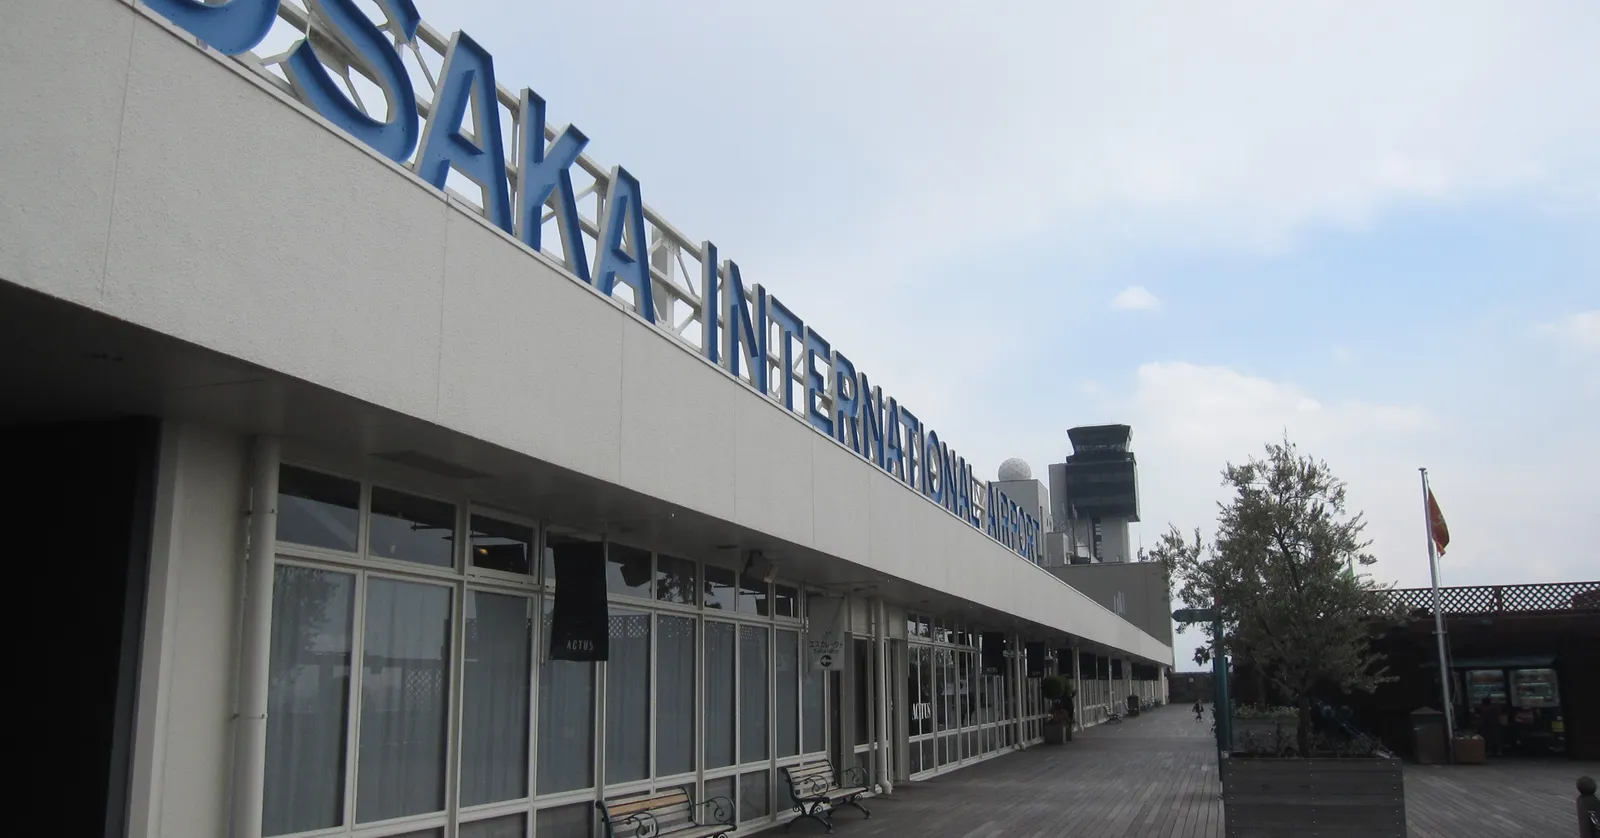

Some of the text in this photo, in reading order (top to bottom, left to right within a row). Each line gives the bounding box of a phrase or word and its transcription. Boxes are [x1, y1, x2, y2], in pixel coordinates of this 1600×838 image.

[138, 0, 1039, 567] SAKA INTERNATIONAL AIRPORT
[566, 639, 594, 651] ACTUS
